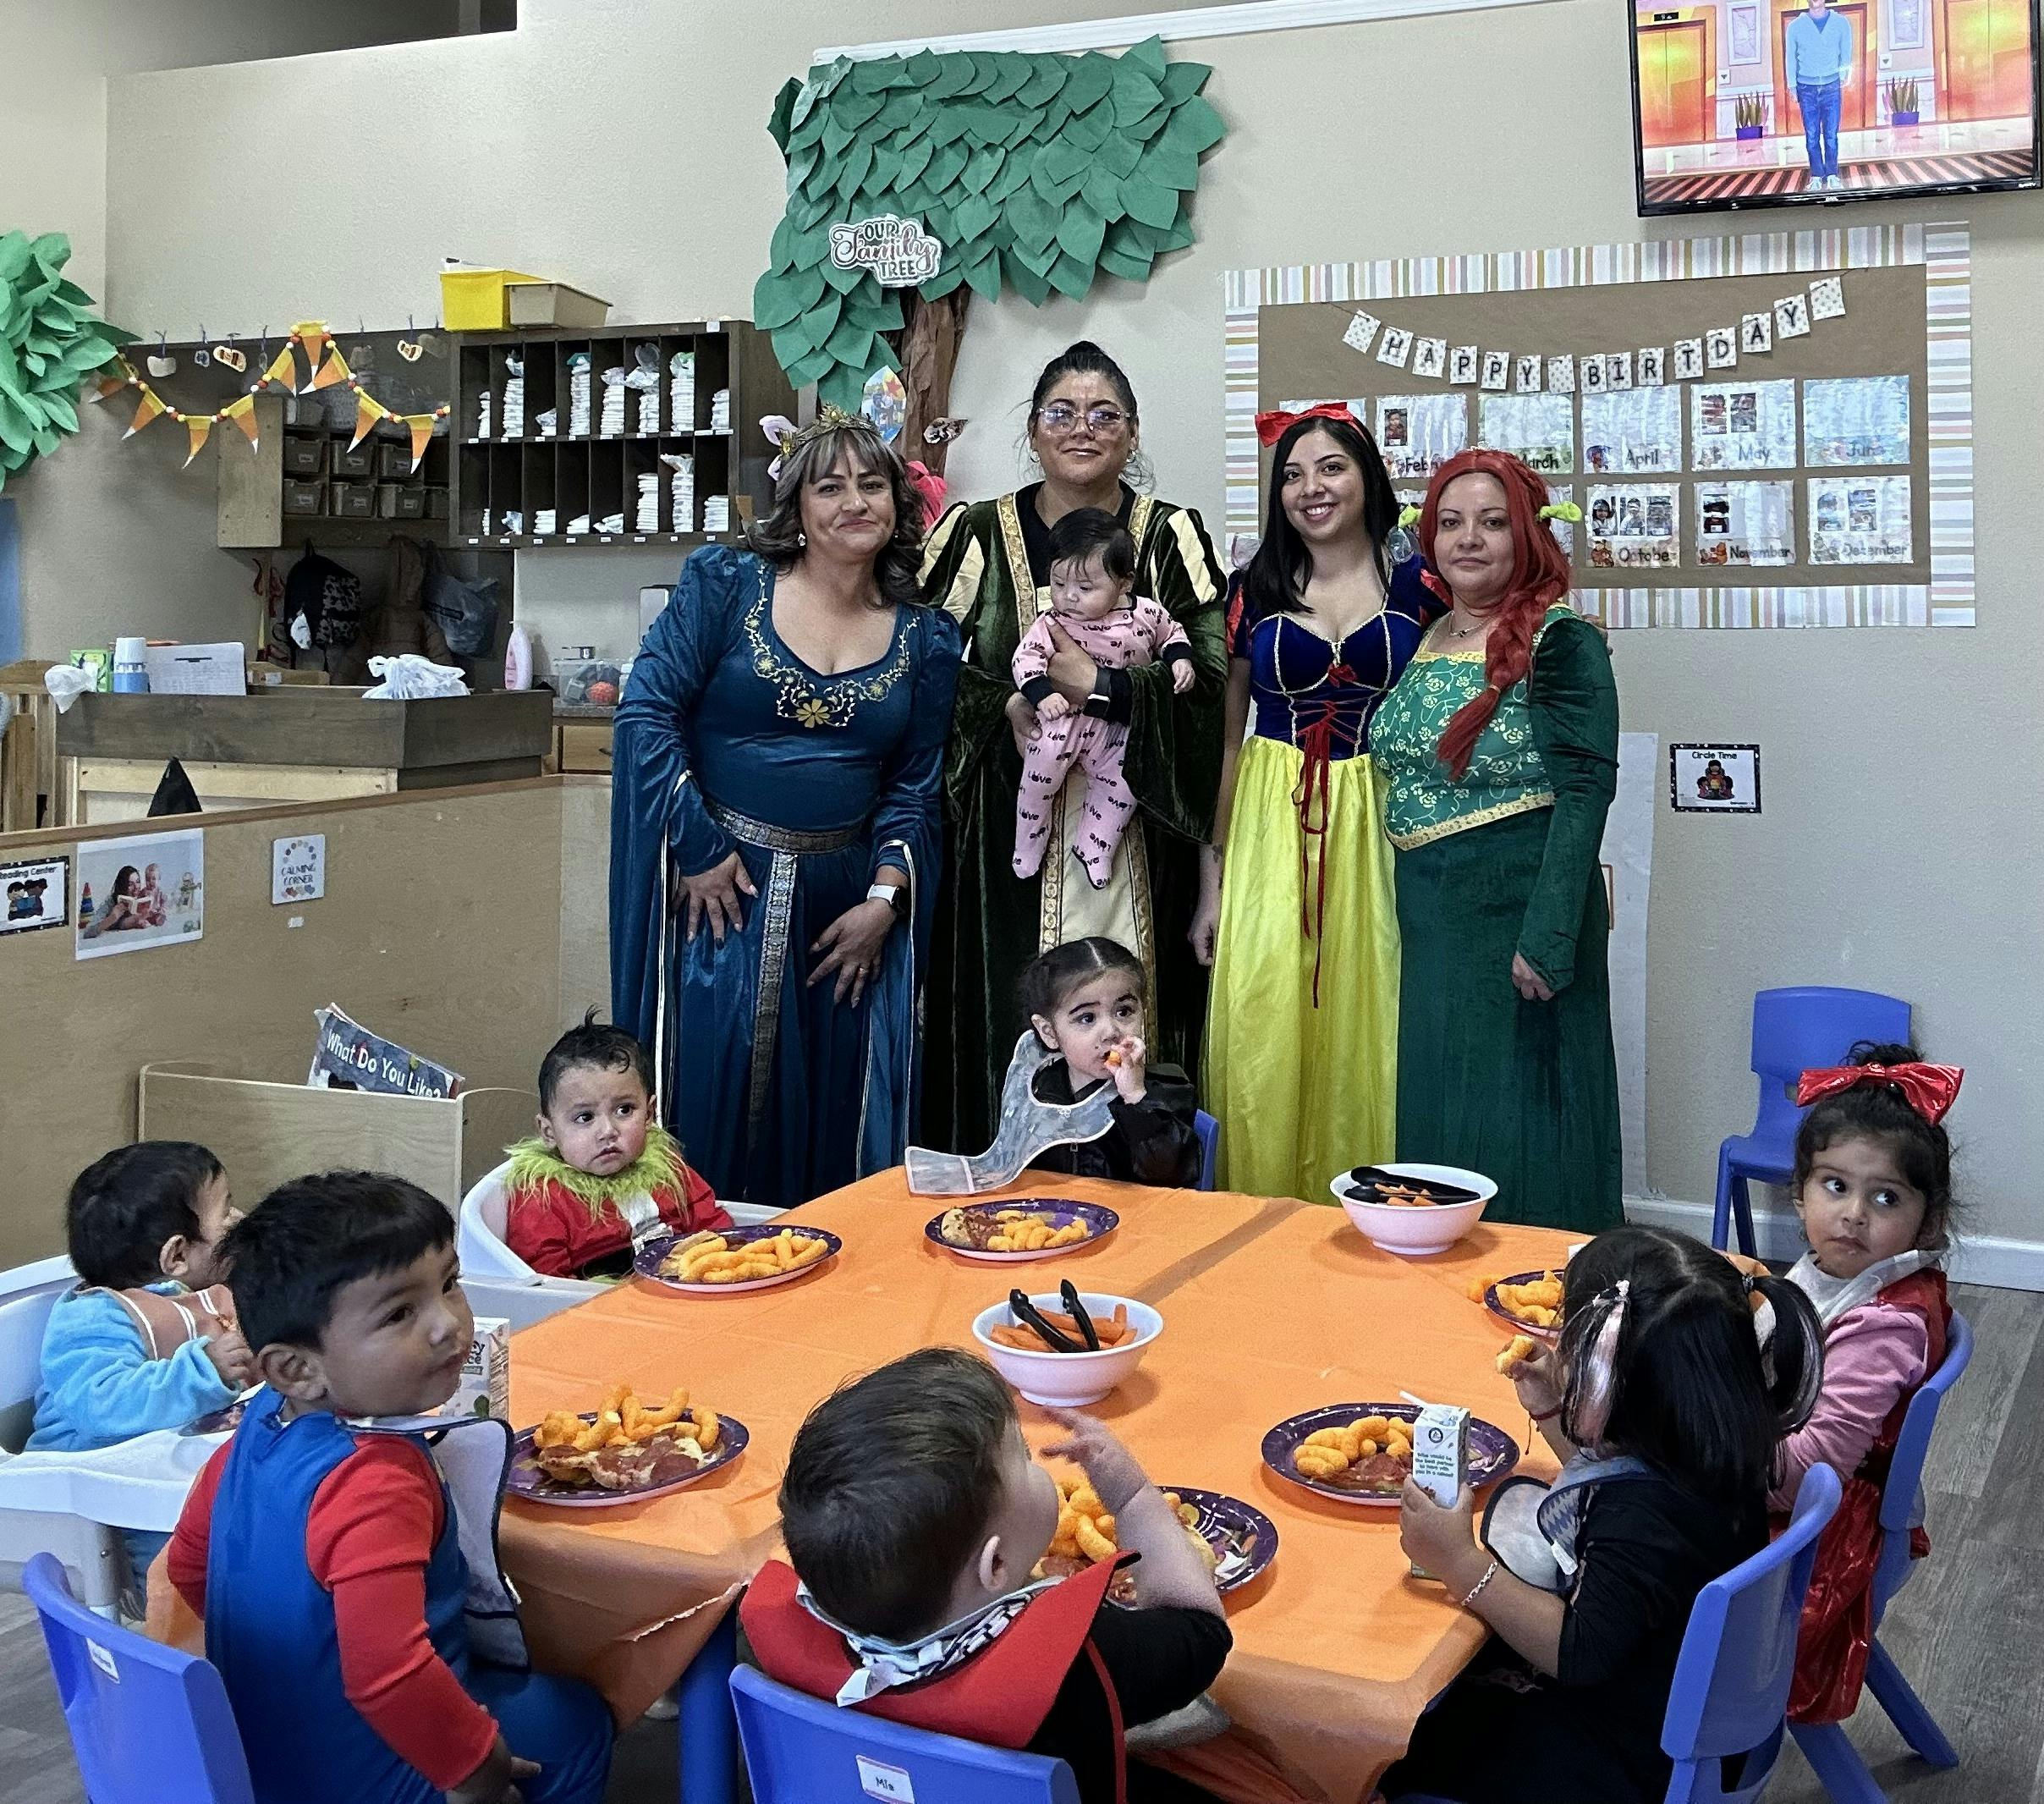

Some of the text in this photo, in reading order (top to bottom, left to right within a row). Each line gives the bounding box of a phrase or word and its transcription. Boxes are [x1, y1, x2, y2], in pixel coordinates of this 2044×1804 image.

[865, 223, 899, 239] OUR
[832, 223, 937, 272] Family
[880, 260, 916, 277] TREE
[1387, 305, 1798, 386] HAPPY BIRTDAY
[1625, 448, 1659, 470] April
[30, 866, 58, 875] Center
[283, 874, 314, 886] CORNER
[327, 1028, 442, 1098] What Do You Like?
